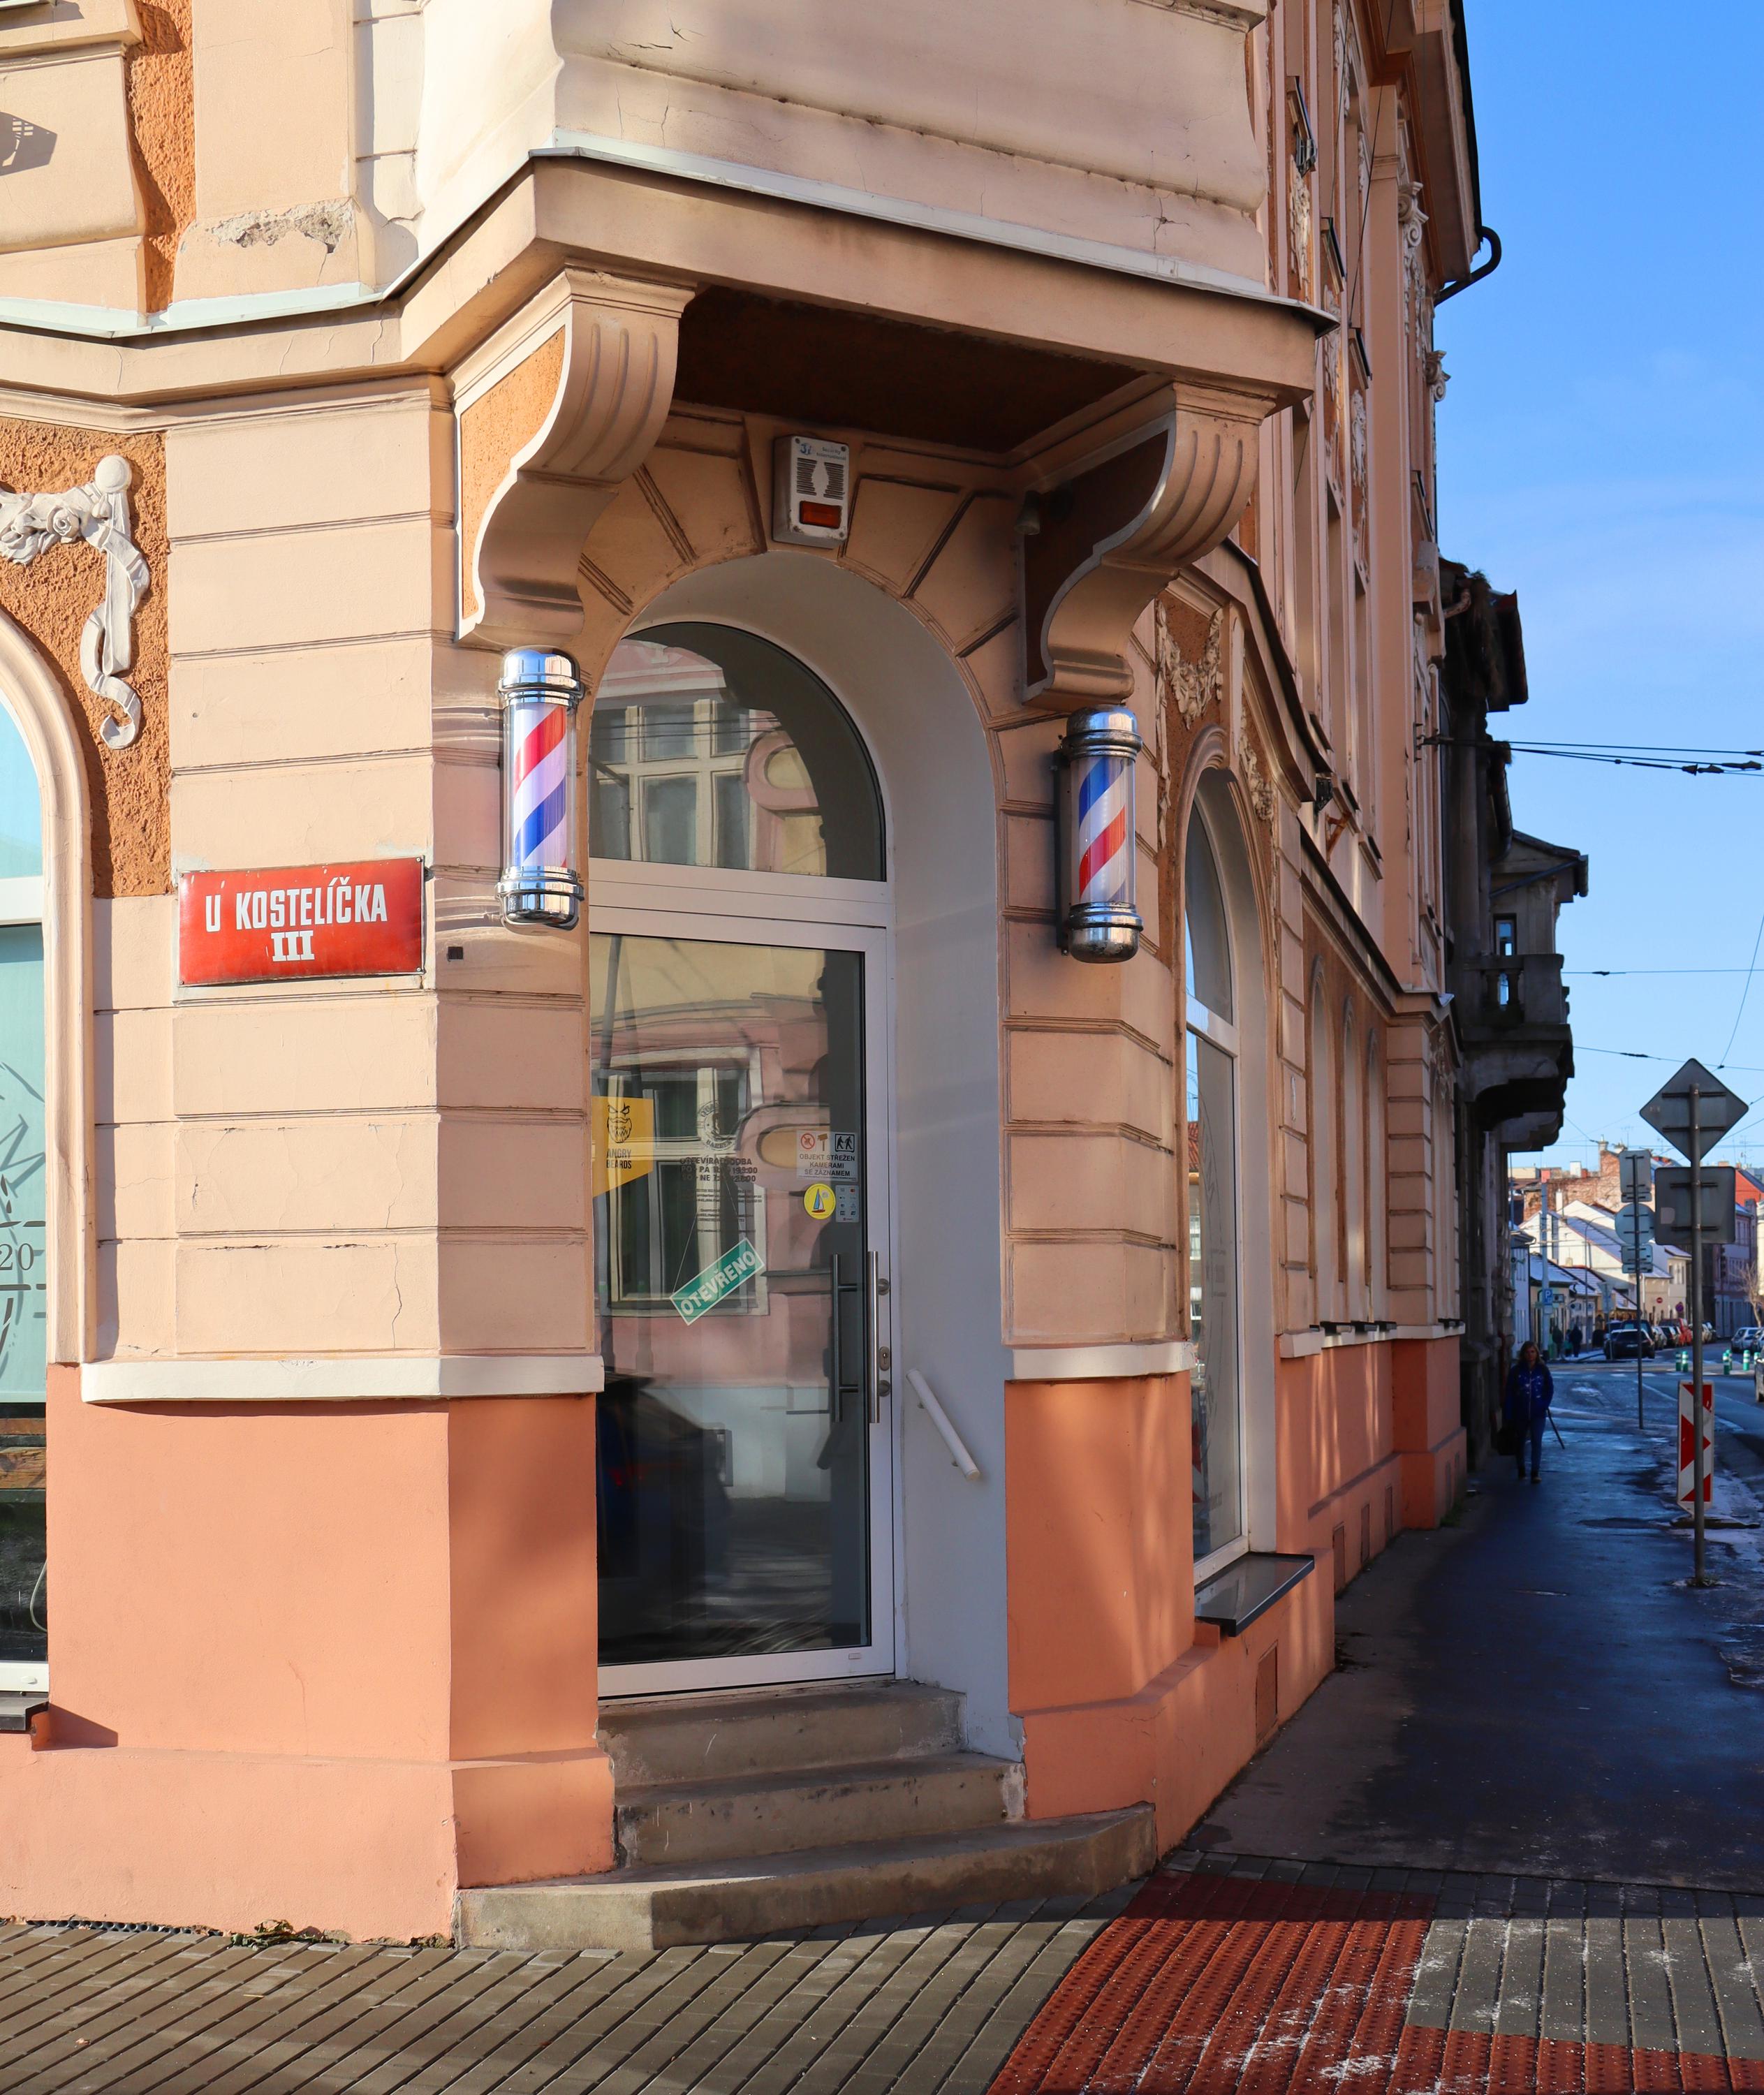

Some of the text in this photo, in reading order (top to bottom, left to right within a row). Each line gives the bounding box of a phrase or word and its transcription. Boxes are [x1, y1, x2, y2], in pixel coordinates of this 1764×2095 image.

[205, 876, 388, 932] U KOSTELÍČKA
[270, 929, 315, 962] III
[606, 1148, 632, 1159] ANGRY
[826, 1153, 855, 1161] STŘEŽEN
[605, 1159, 632, 1169] BEARDS
[814, 1168, 851, 1177] ZÁZNAMEM
[680, 1251, 756, 1314] OTEVŘENO
